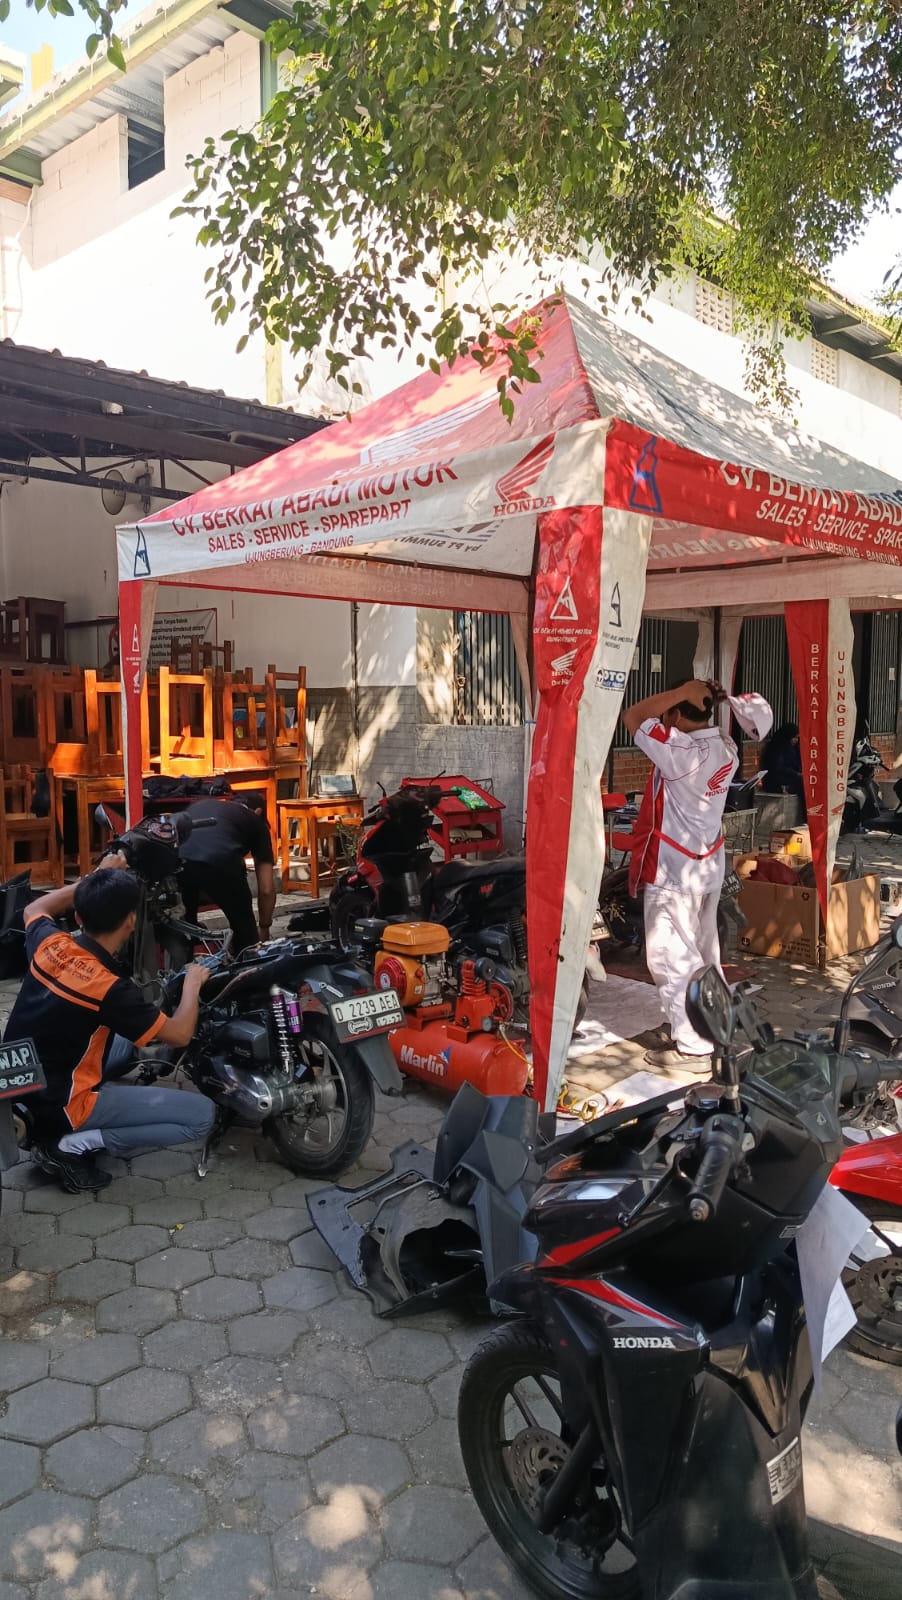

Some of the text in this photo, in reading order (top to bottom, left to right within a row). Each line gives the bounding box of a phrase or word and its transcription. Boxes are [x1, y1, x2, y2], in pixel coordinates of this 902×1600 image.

[719, 461, 760, 492] CV.
[768, 474, 850, 514] BERKAT
[493, 495, 557, 517] HONDA
[756, 500, 807, 528] SALES
[813, 513, 870, 543] SERVICE
[209, 532, 245, 553] SALES
[254, 520, 310, 546] SERVICE
[320, 499, 411, 533] SPAREPART
[310, 535, 354, 553] BANDUNG
[866, 550, 900, 566] BANDUNG
[809, 643, 819, 798] BERKAT ABADI
[837, 651, 846, 792] UJUNGBERUNG
[336, 994, 400, 1021] D 2239 AEA
[401, 1045, 445, 1076] Marlin
[613, 1336, 676, 1349] HONDA
